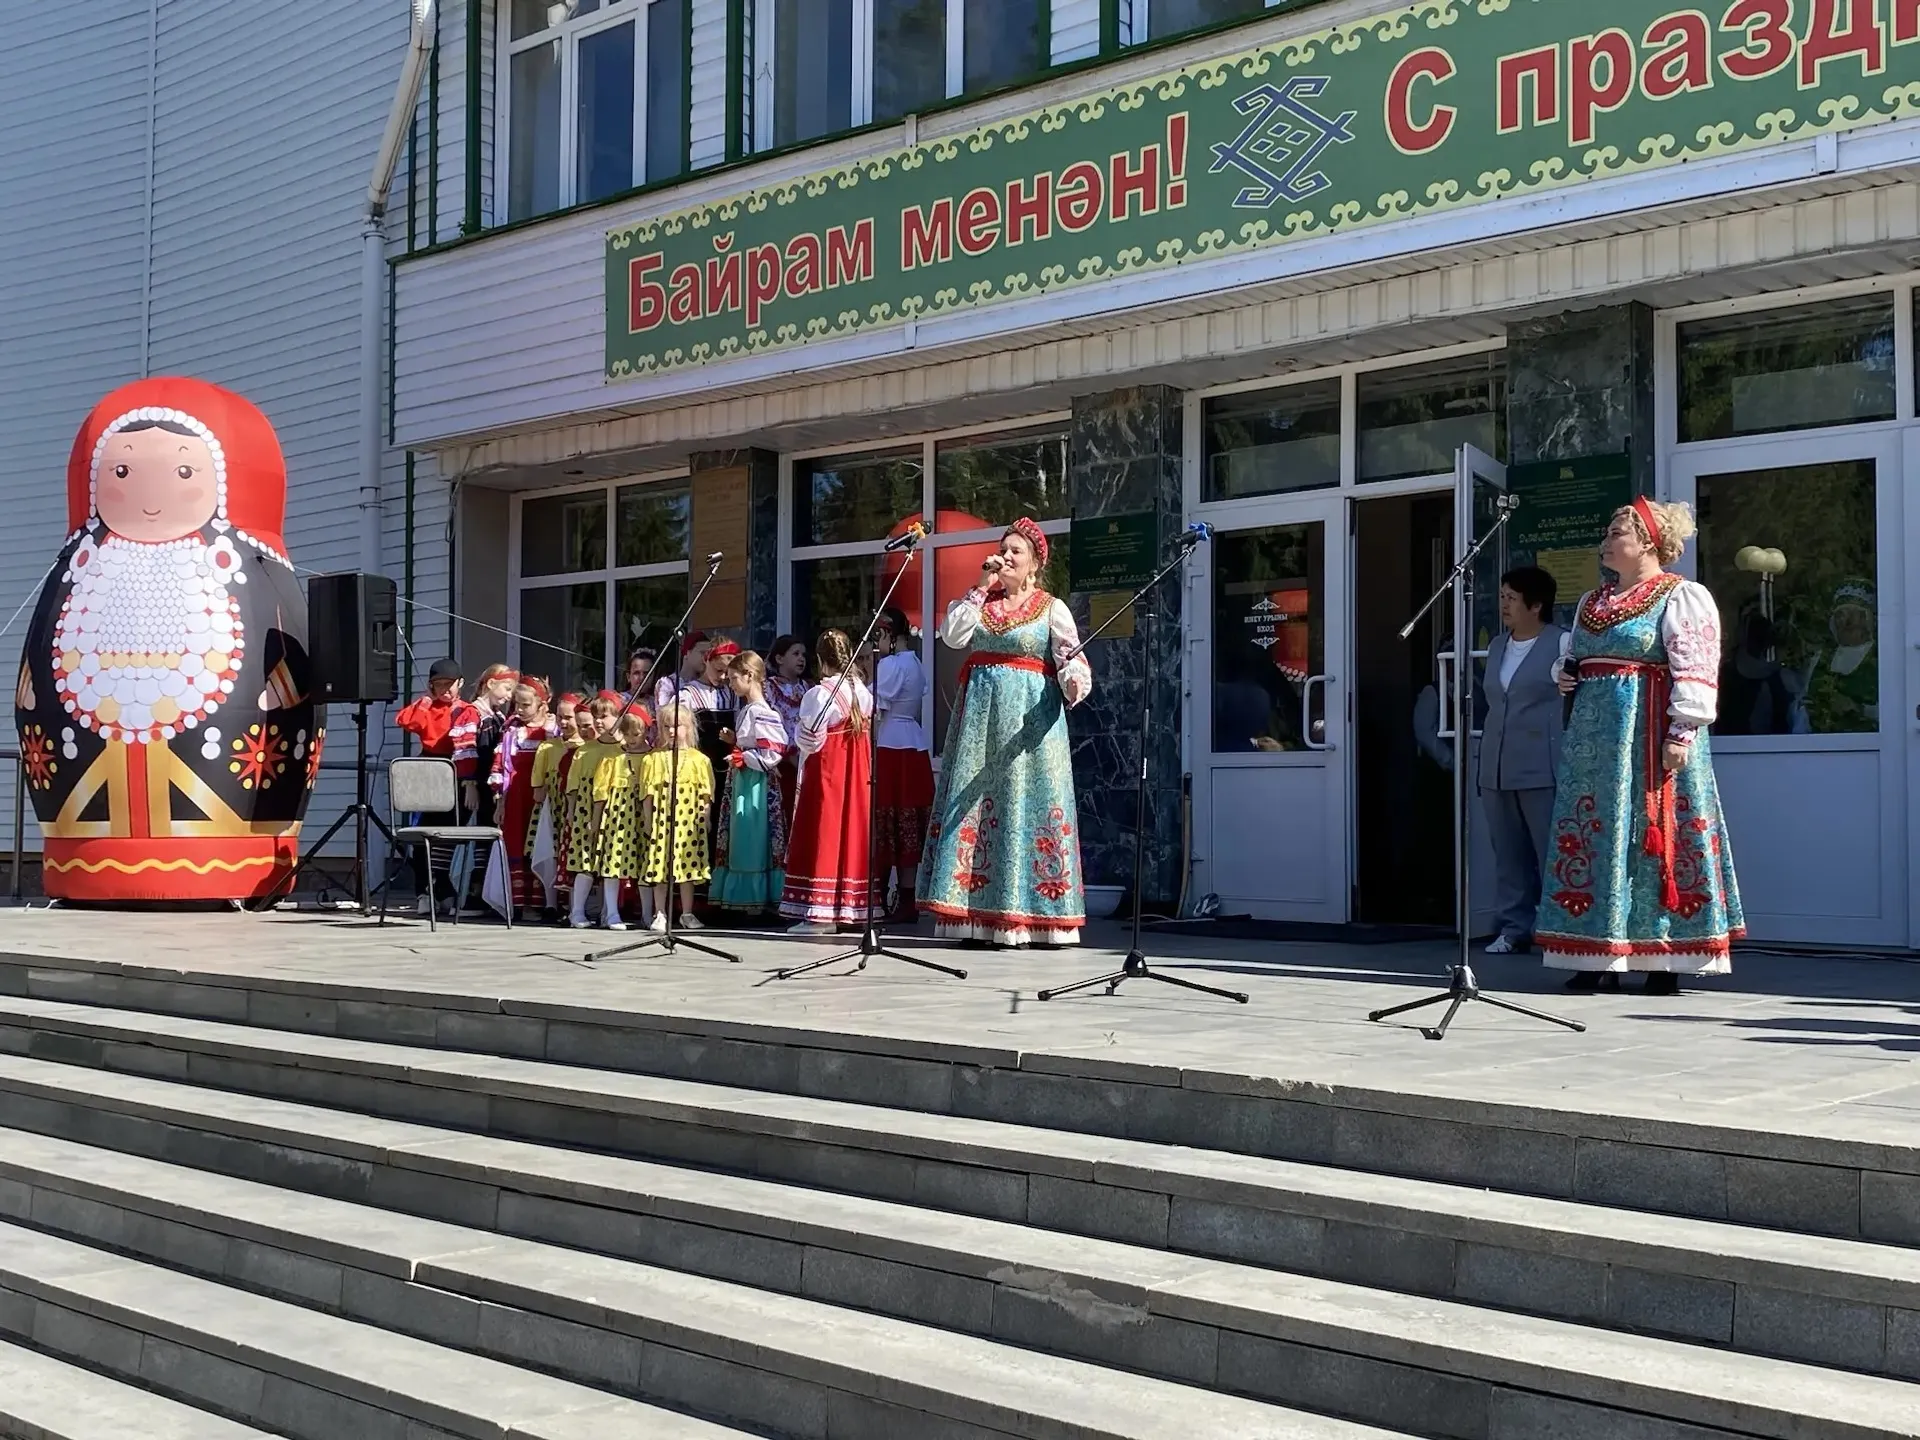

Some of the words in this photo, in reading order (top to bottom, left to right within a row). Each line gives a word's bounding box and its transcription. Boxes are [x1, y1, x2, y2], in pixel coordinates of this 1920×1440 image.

[629, 217, 874, 334] Байрам
[901, 111, 1189, 272] менән!
[1384, 46, 1457, 155] С
[1497, 0, 1920, 147] празд
